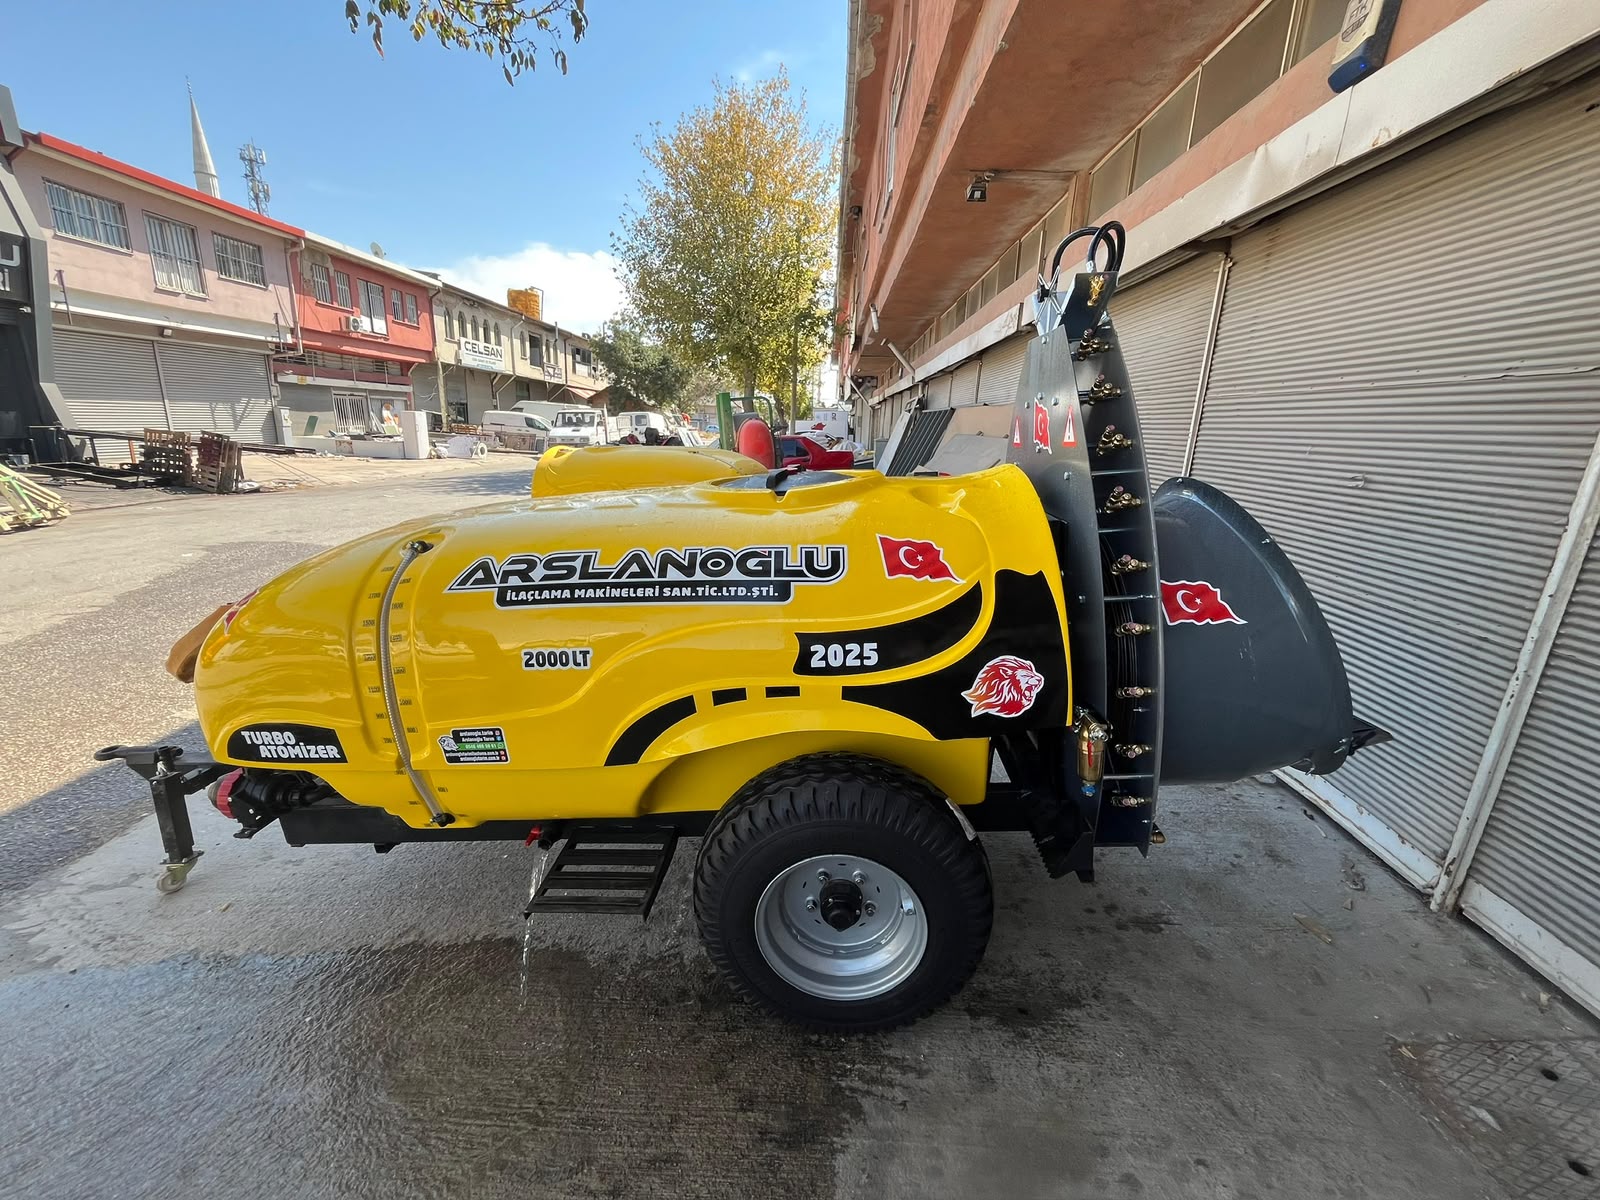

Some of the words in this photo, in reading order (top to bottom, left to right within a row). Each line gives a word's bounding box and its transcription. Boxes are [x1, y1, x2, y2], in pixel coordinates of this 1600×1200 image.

[464, 340, 503, 359] CELSAN
[506, 588, 571, 602] İLAÇLAMA
[574, 585, 660, 598] MAKİNELERİ
[810, 642, 879, 668] 2025
[241, 731, 296, 745] TURBO
[259, 742, 341, 758] ATOMİZER
